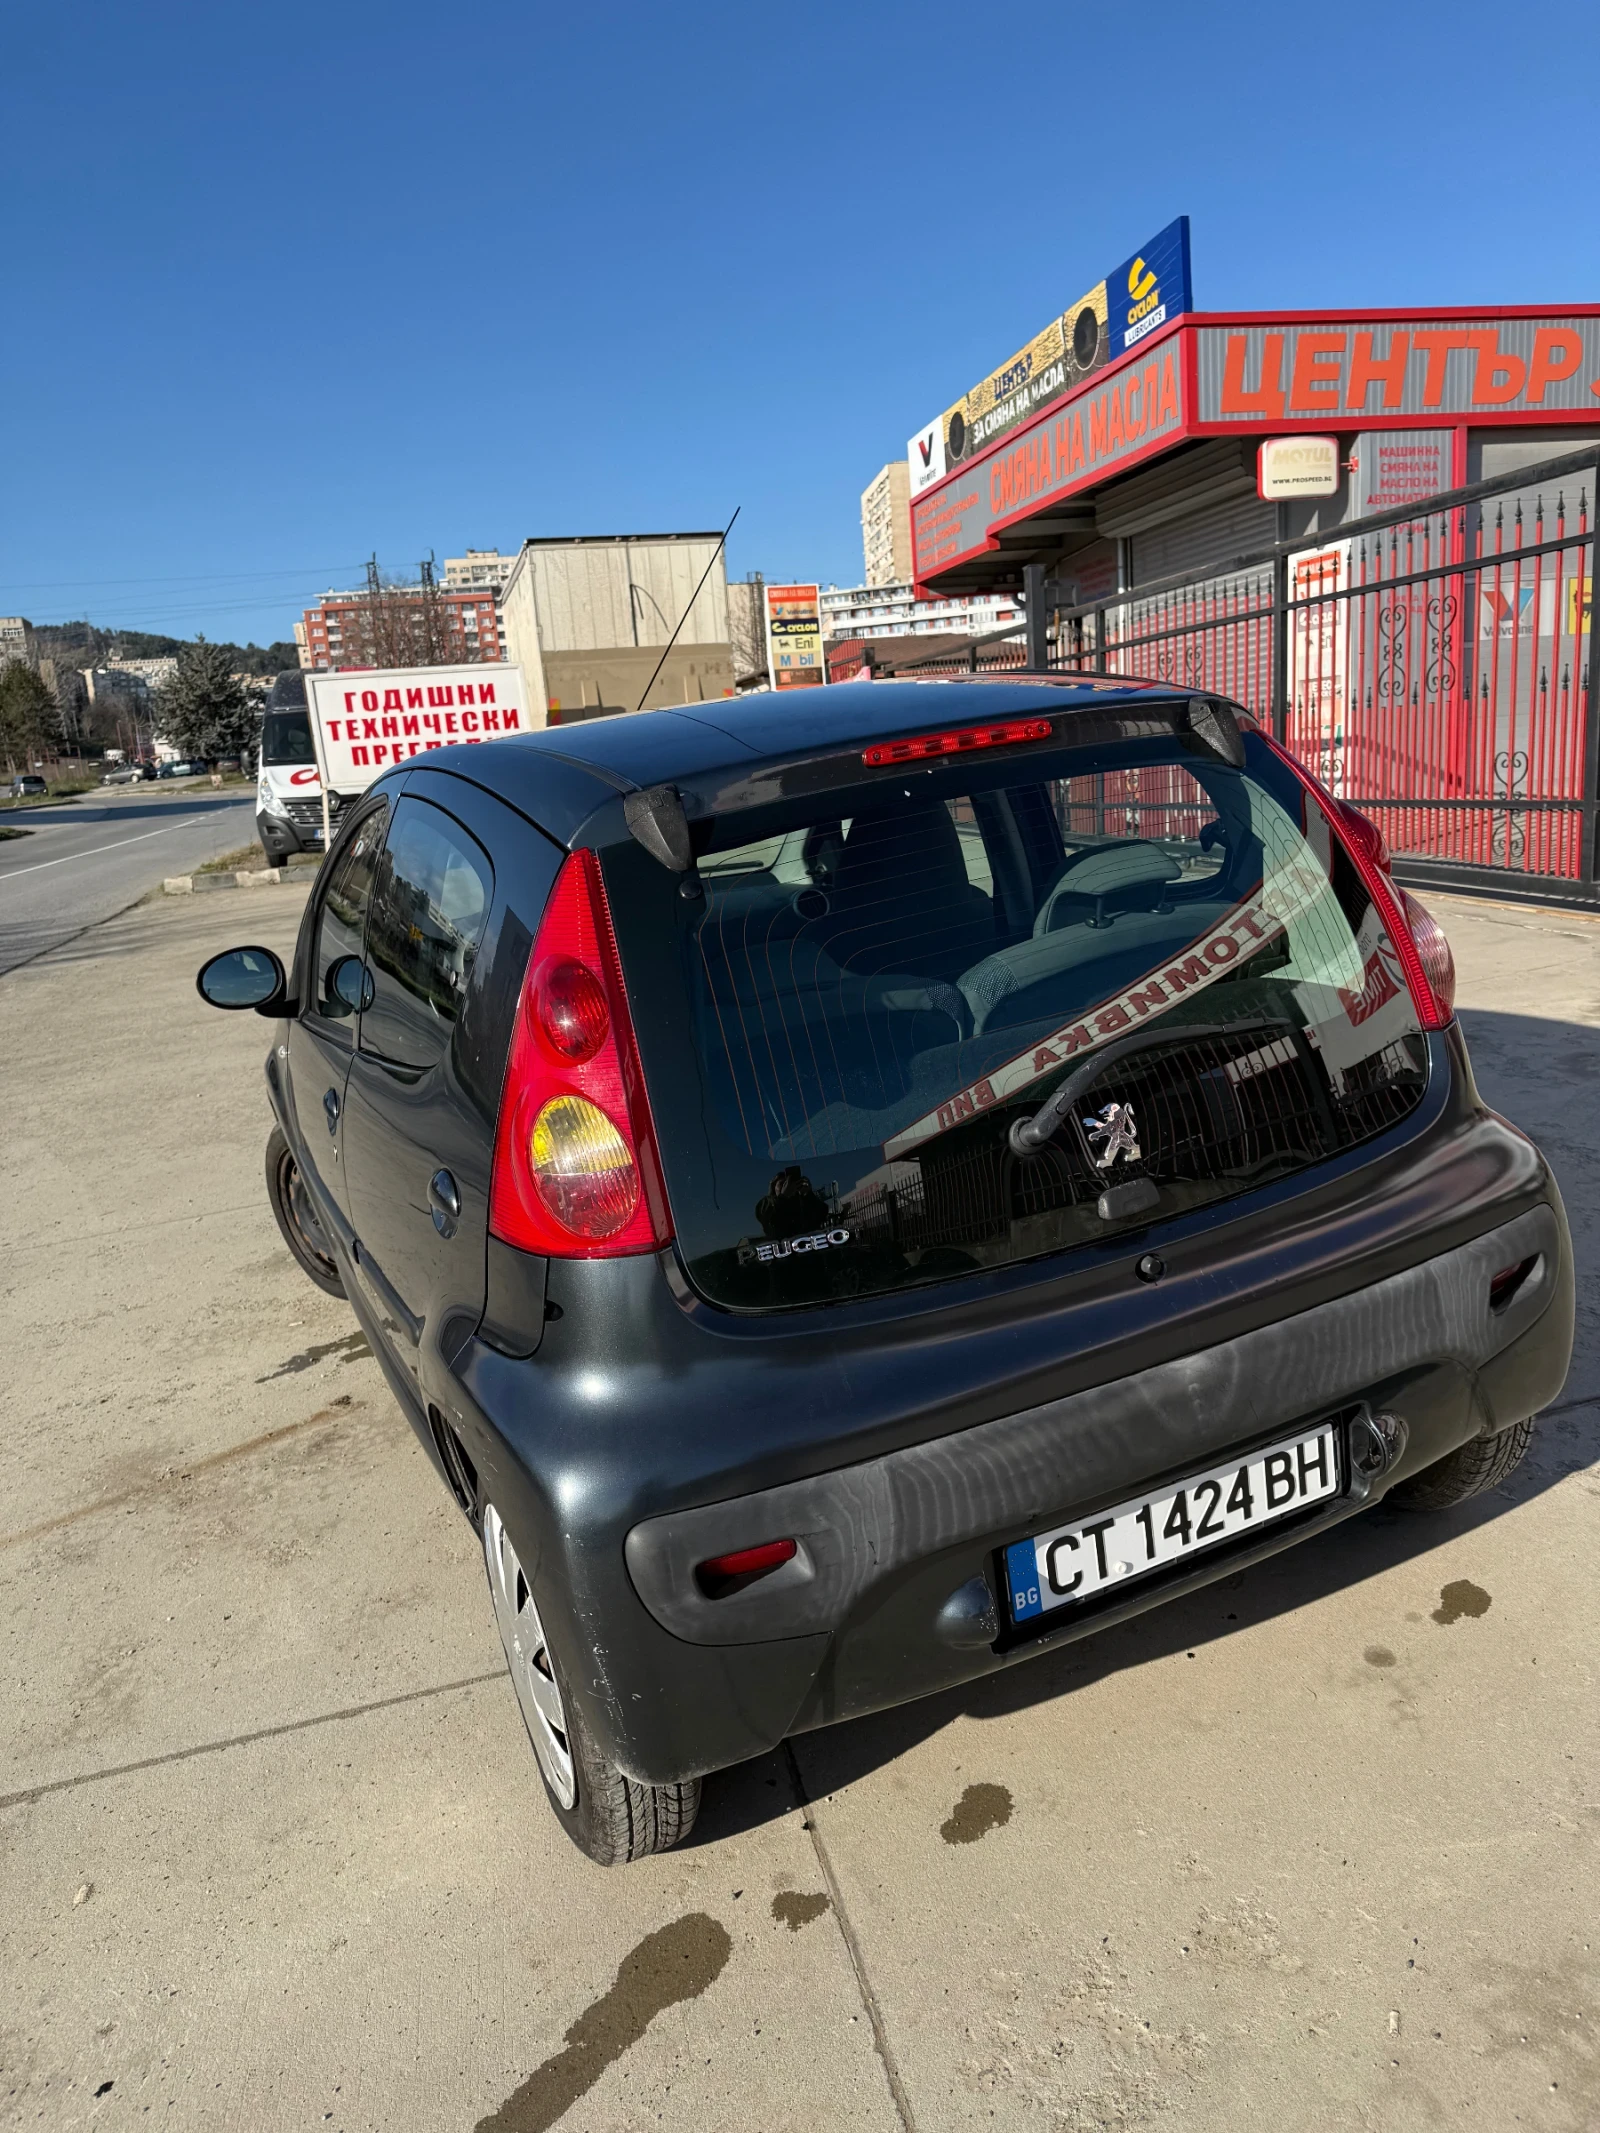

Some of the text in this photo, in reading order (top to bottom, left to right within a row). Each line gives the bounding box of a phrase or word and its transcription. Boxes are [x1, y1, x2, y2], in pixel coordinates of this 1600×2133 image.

[1127, 290, 1159, 325] CYCLON
[1220, 328, 1583, 420] ЦЕНТЪР
[985, 399, 1016, 435] СМЯНА
[1015, 388, 1031, 414] НА
[1031, 362, 1065, 401] МАСЛА
[990, 431, 1052, 515] СМЯНА
[1055, 410, 1086, 481] НА
[1089, 352, 1179, 463] МАСЛА
[1379, 446, 1440, 458] МАШИННА
[1380, 462, 1439, 474] СМЯНА НА
[1380, 477, 1439, 489] МАСЛО НА
[787, 623, 818, 633] CYCLON
[795, 637, 814, 649] Eni
[343, 683, 496, 714] ГОДИШНИ
[326, 709, 520, 742] ТЕХНИЧЕСКИ
[1045, 1434, 1329, 1596] CT 1424 BH
[1015, 1586, 1038, 1611] BG
